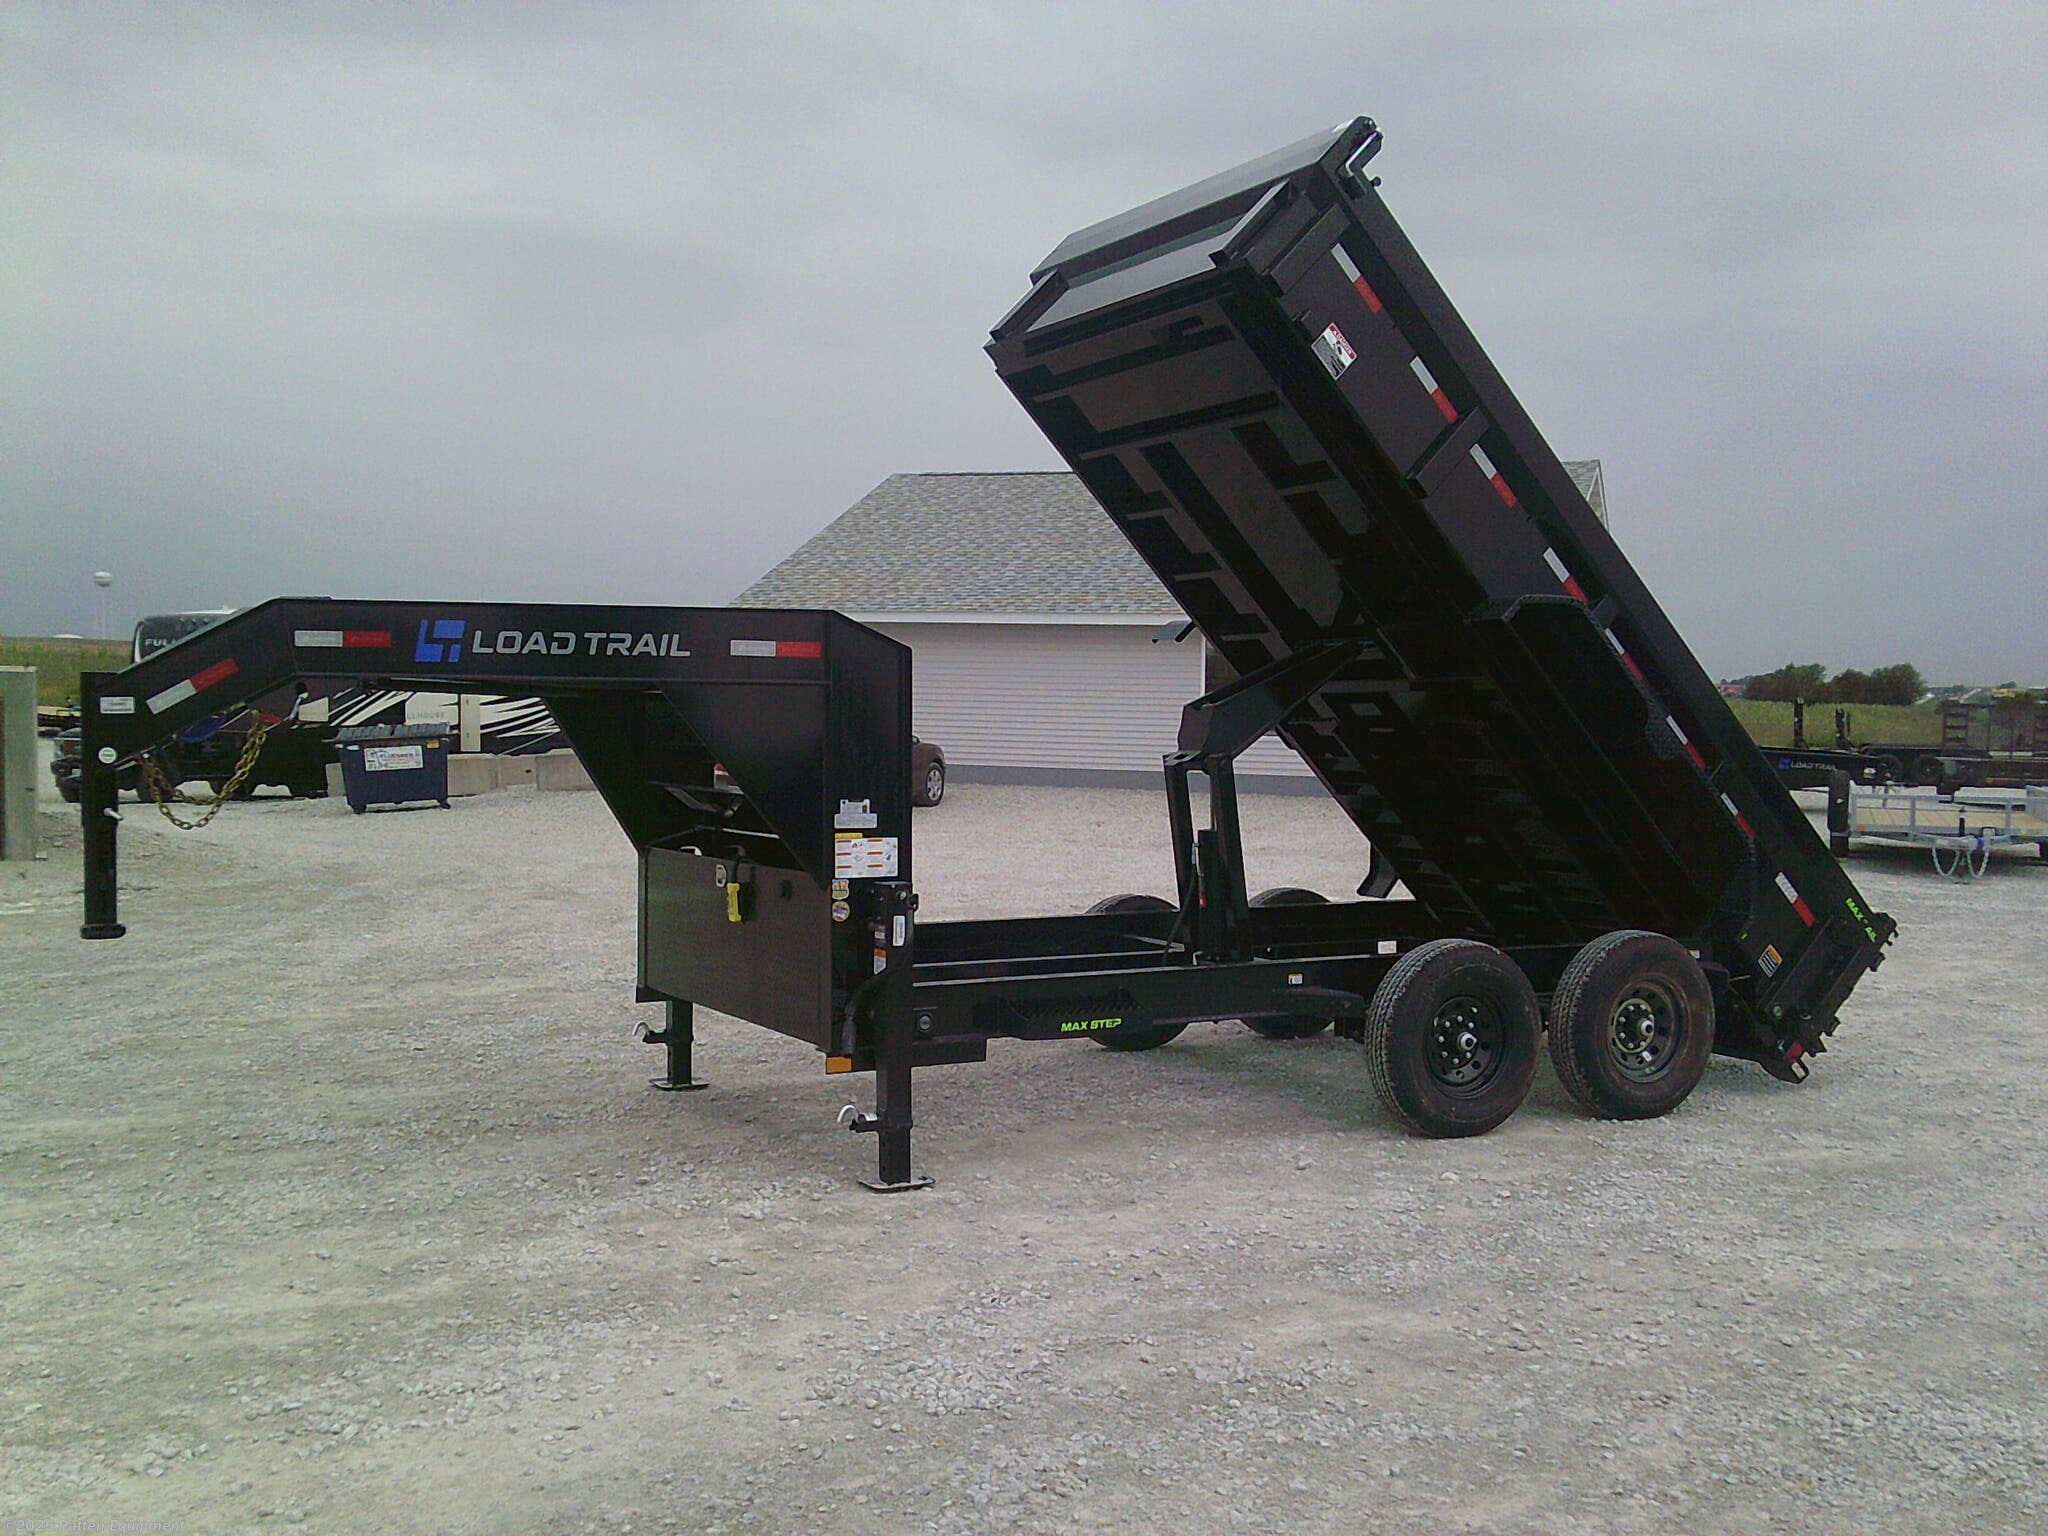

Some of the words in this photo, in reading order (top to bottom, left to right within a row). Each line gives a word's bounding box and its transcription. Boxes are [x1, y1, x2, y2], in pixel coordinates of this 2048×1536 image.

[472, 630, 576, 655] LOAD
[584, 632, 691, 657] TRAIL
[1790, 761, 1813, 769] LOAD
[1845, 897, 1865, 920] MAX
[1061, 1021, 1088, 1032] MAX
[1090, 1018, 1121, 1030] STEP
